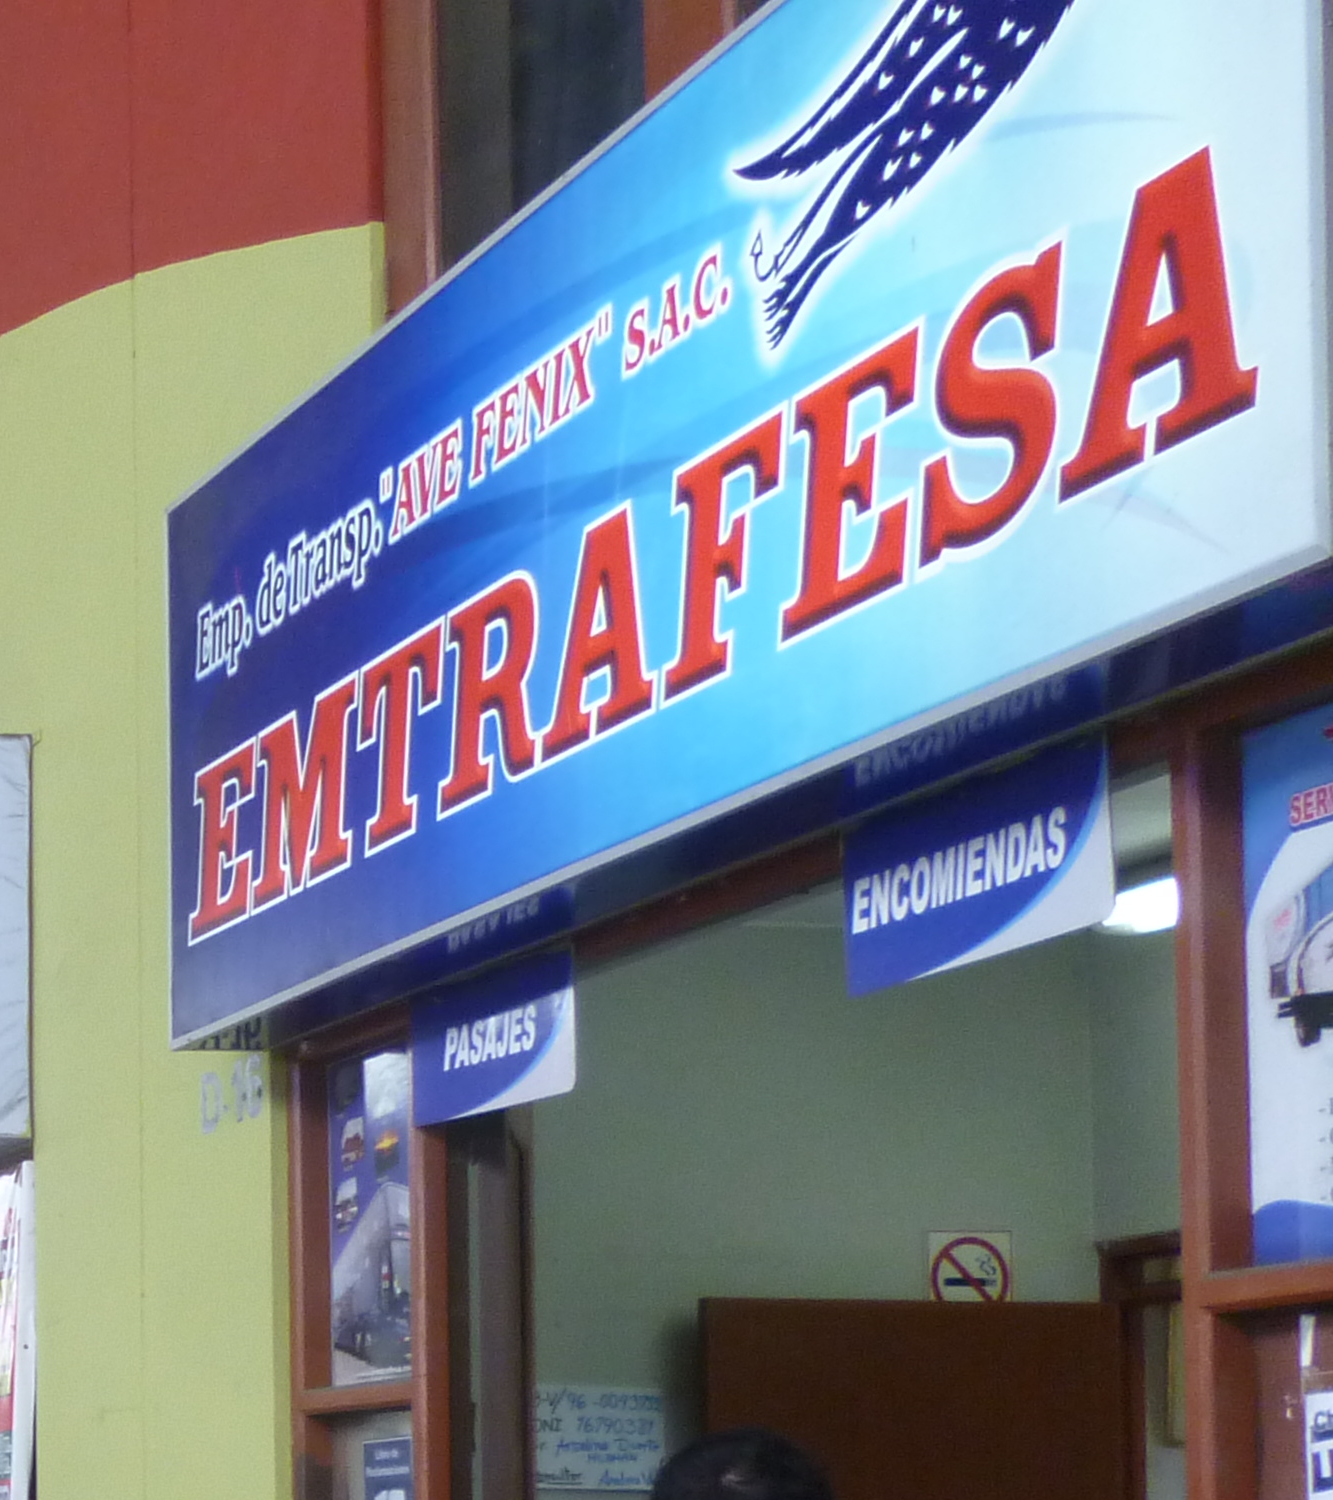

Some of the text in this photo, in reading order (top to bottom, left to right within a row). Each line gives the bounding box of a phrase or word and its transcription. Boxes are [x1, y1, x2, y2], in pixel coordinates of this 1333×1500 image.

[189, 145, 1258, 943] EMTRAFESA
[196, 598, 252, 678] Emp.
[257, 552, 286, 632] de
[288, 501, 383, 614] Transp.
[470, 305, 611, 485] FENIX"
[622, 246, 733, 376] S.A.C.
[852, 806, 1066, 934] ENCOMIENDAS
[443, 1005, 537, 1071] PASAJES
